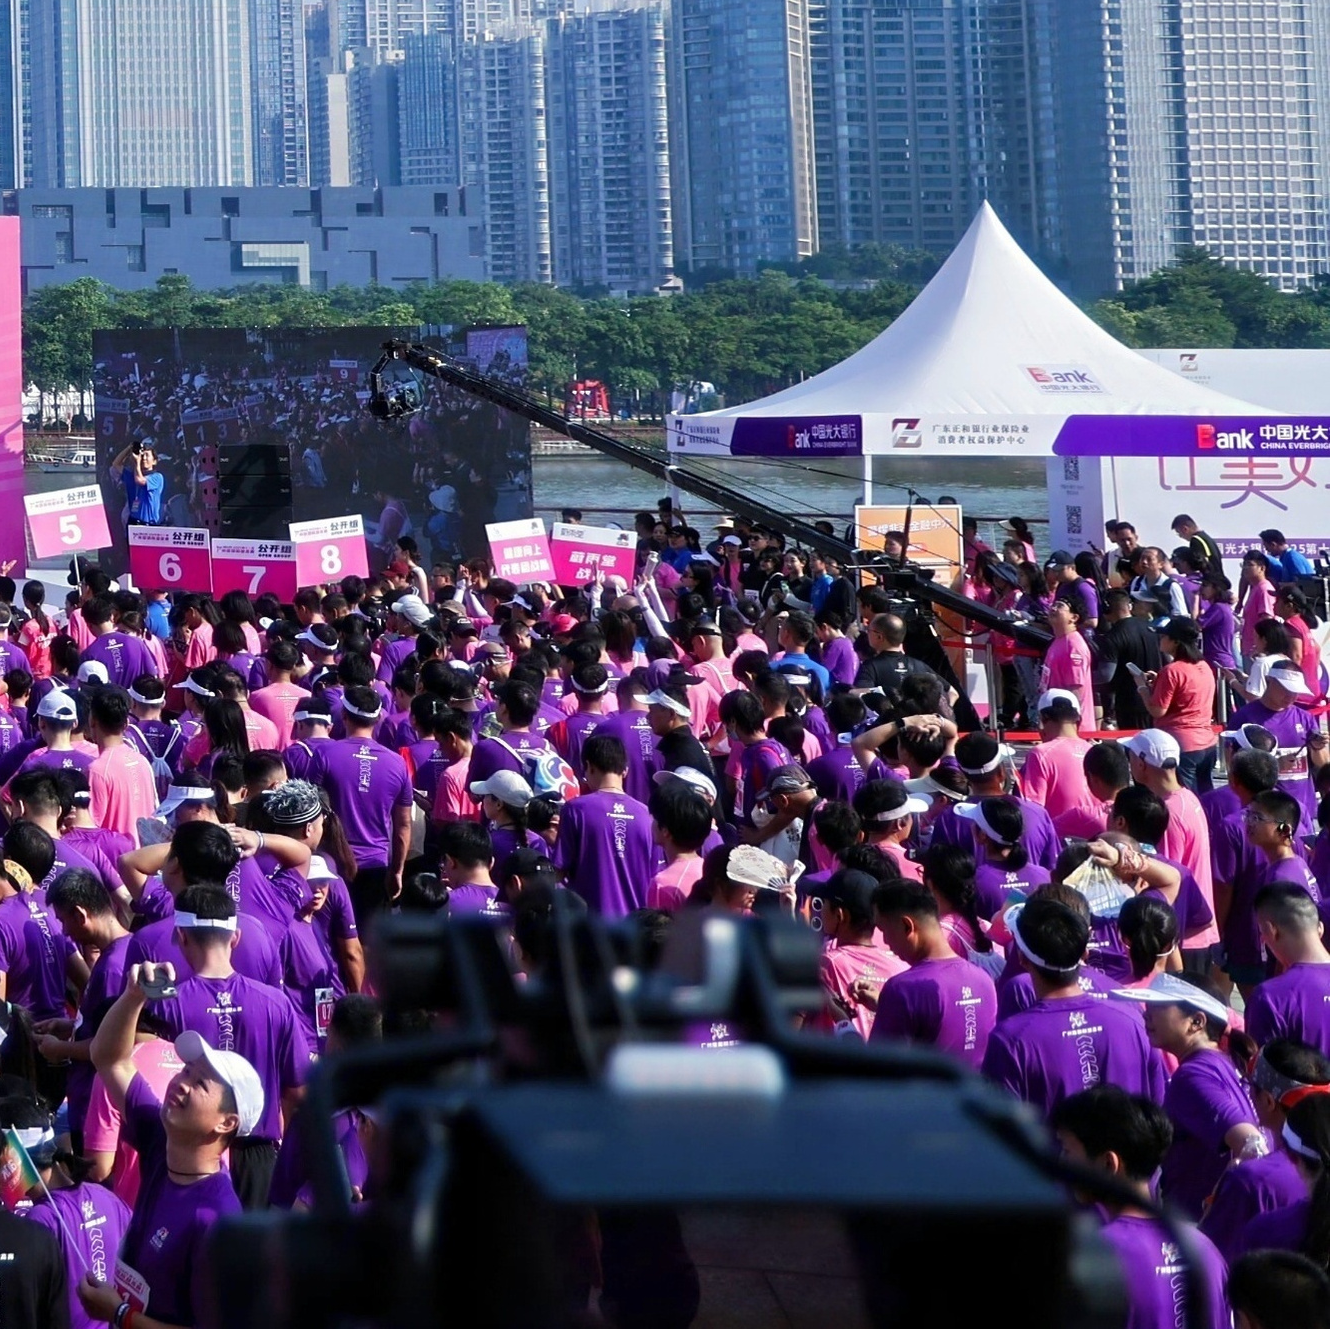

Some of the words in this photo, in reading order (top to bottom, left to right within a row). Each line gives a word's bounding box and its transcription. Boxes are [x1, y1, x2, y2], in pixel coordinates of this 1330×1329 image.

[1027, 367, 1094, 383] Bank
[811, 424, 857, 439] 中国光大银行
[932, 424, 1030, 434] 广东正和银行业保险业
[1197, 424, 1255, 449] Bank
[1260, 424, 1330, 440] 中国光大
[938, 435, 1025, 445] 消费者权益保护中心
[1260, 442, 1287, 450] CHINA
[59, 514, 82, 545] 5
[172, 531, 205, 542] 公开组
[258, 544, 292, 554] 公开组
[159, 552, 182, 582] 6
[320, 544, 342, 575] 8
[242, 565, 266, 594] 7
